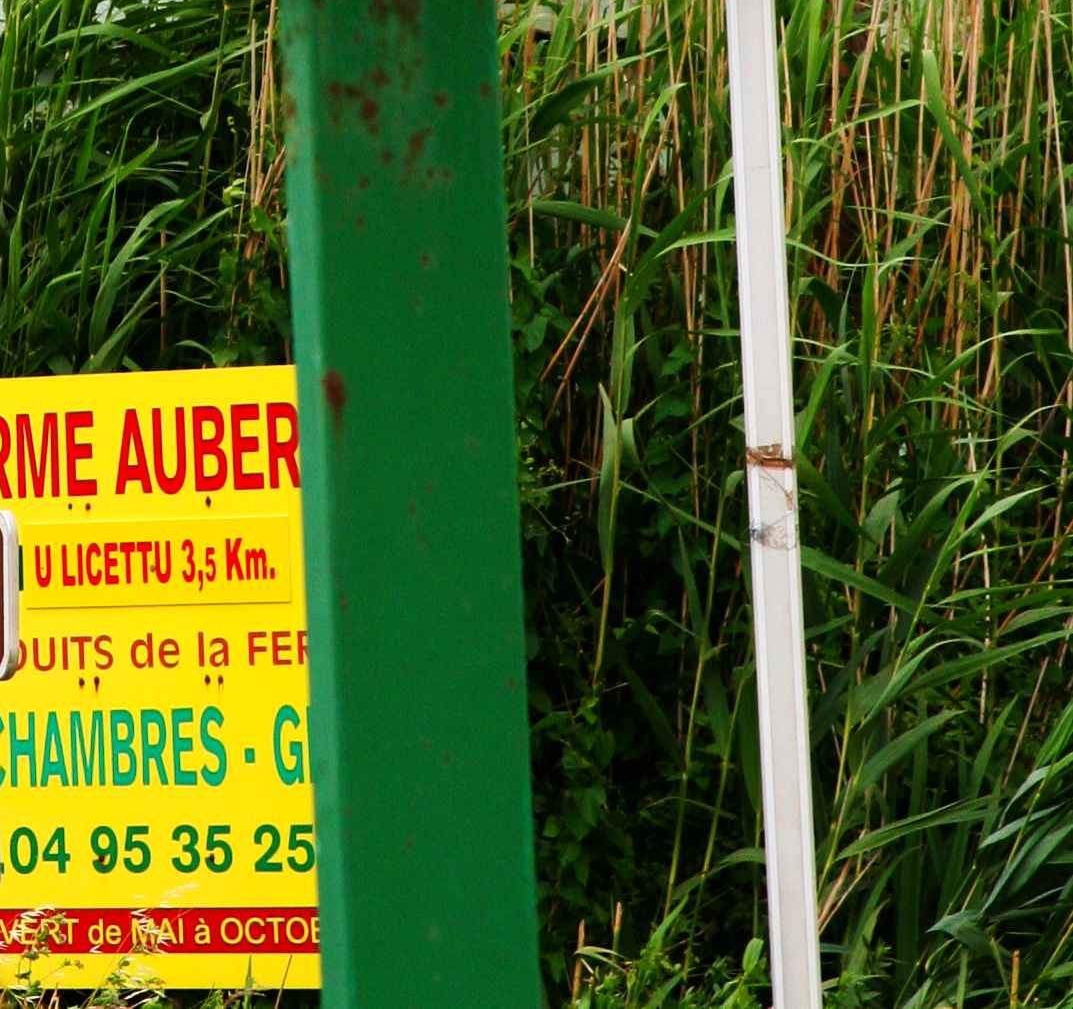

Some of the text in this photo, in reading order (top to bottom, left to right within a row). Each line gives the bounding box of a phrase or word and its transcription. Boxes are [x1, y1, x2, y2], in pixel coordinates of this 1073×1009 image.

[115, 402, 300, 495] AUBER
[35, 538, 276, 591] U LICETTU 3,5 Km.
[130, 632, 180, 668] de
[198, 631, 229, 667] la
[90, 825, 151, 874] 95
[171, 824, 233, 874] 35
[254, 824, 316, 873] 25
[87, 917, 121, 946] de
[132, 916, 184, 945] MAI
[194, 916, 210, 944] à
